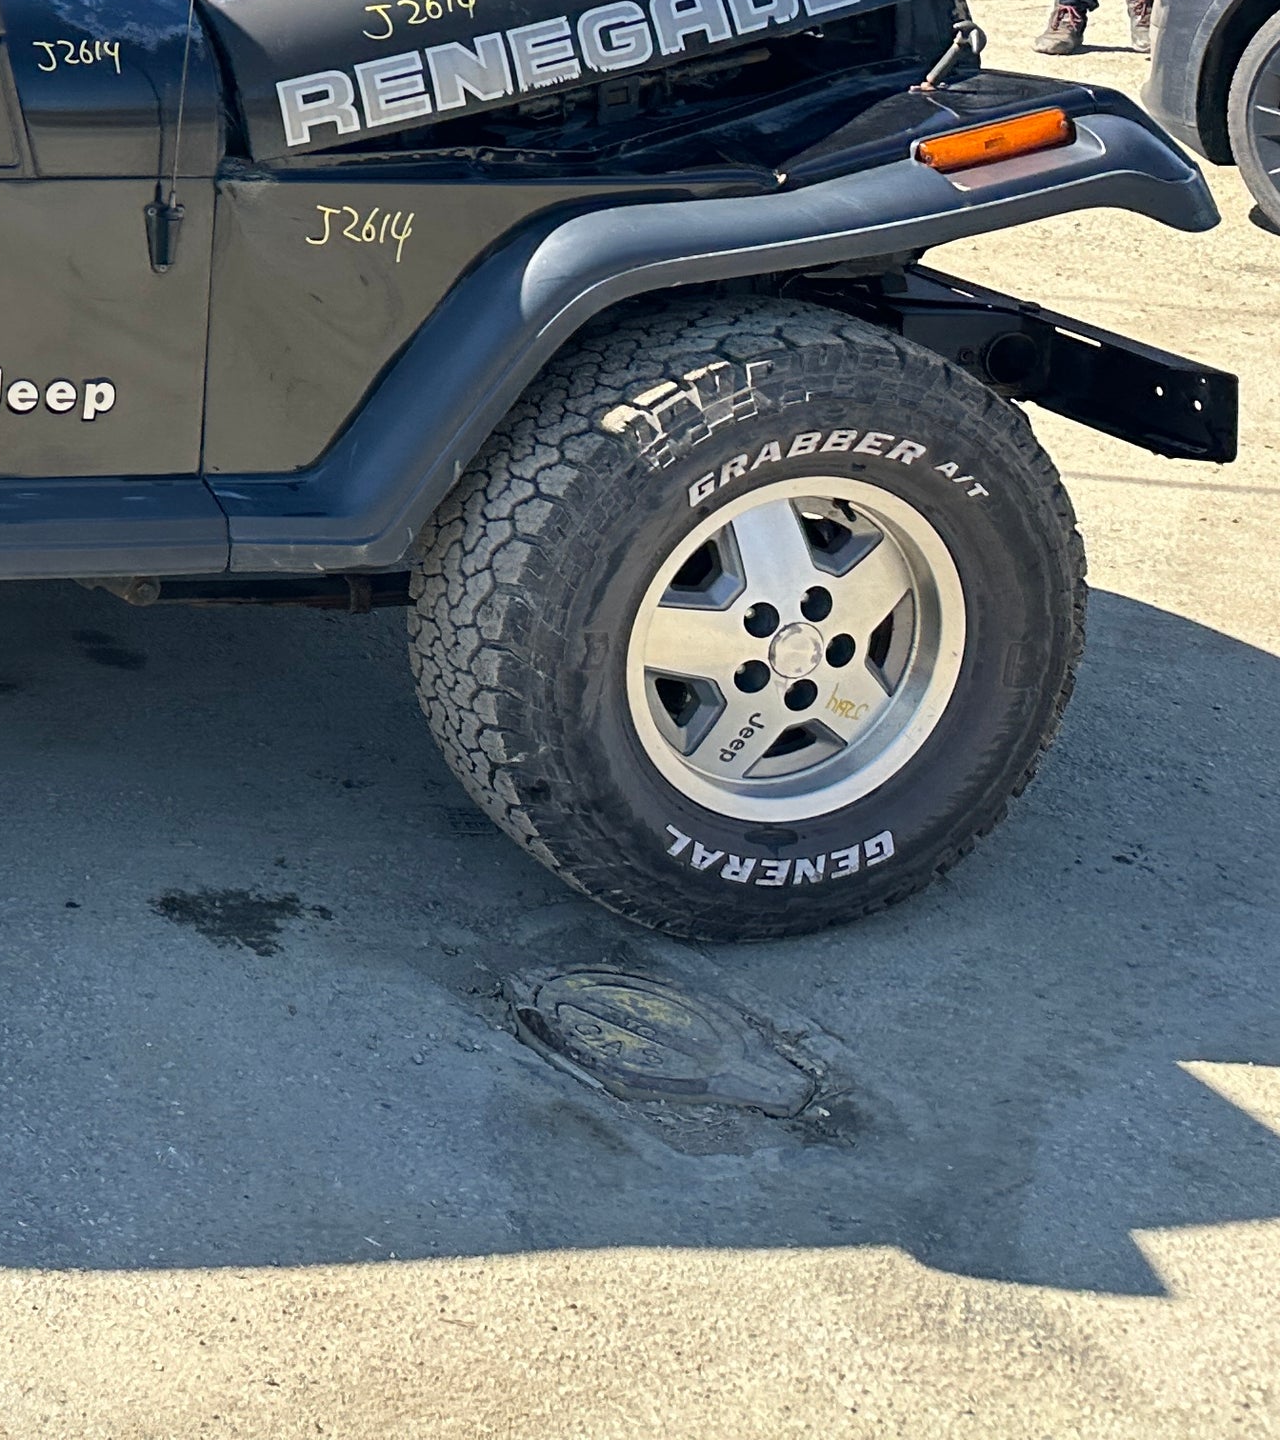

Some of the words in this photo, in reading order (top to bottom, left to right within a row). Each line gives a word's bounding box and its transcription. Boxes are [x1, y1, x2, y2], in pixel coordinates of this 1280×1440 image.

[33, 40, 120, 74] J2614
[306, 205, 414, 263] J2614
[687, 429, 927, 507] GRABBER
[934, 460, 991, 500] A/T
[718, 712, 765, 764] Jeep
[664, 823, 896, 886] GENERAL
